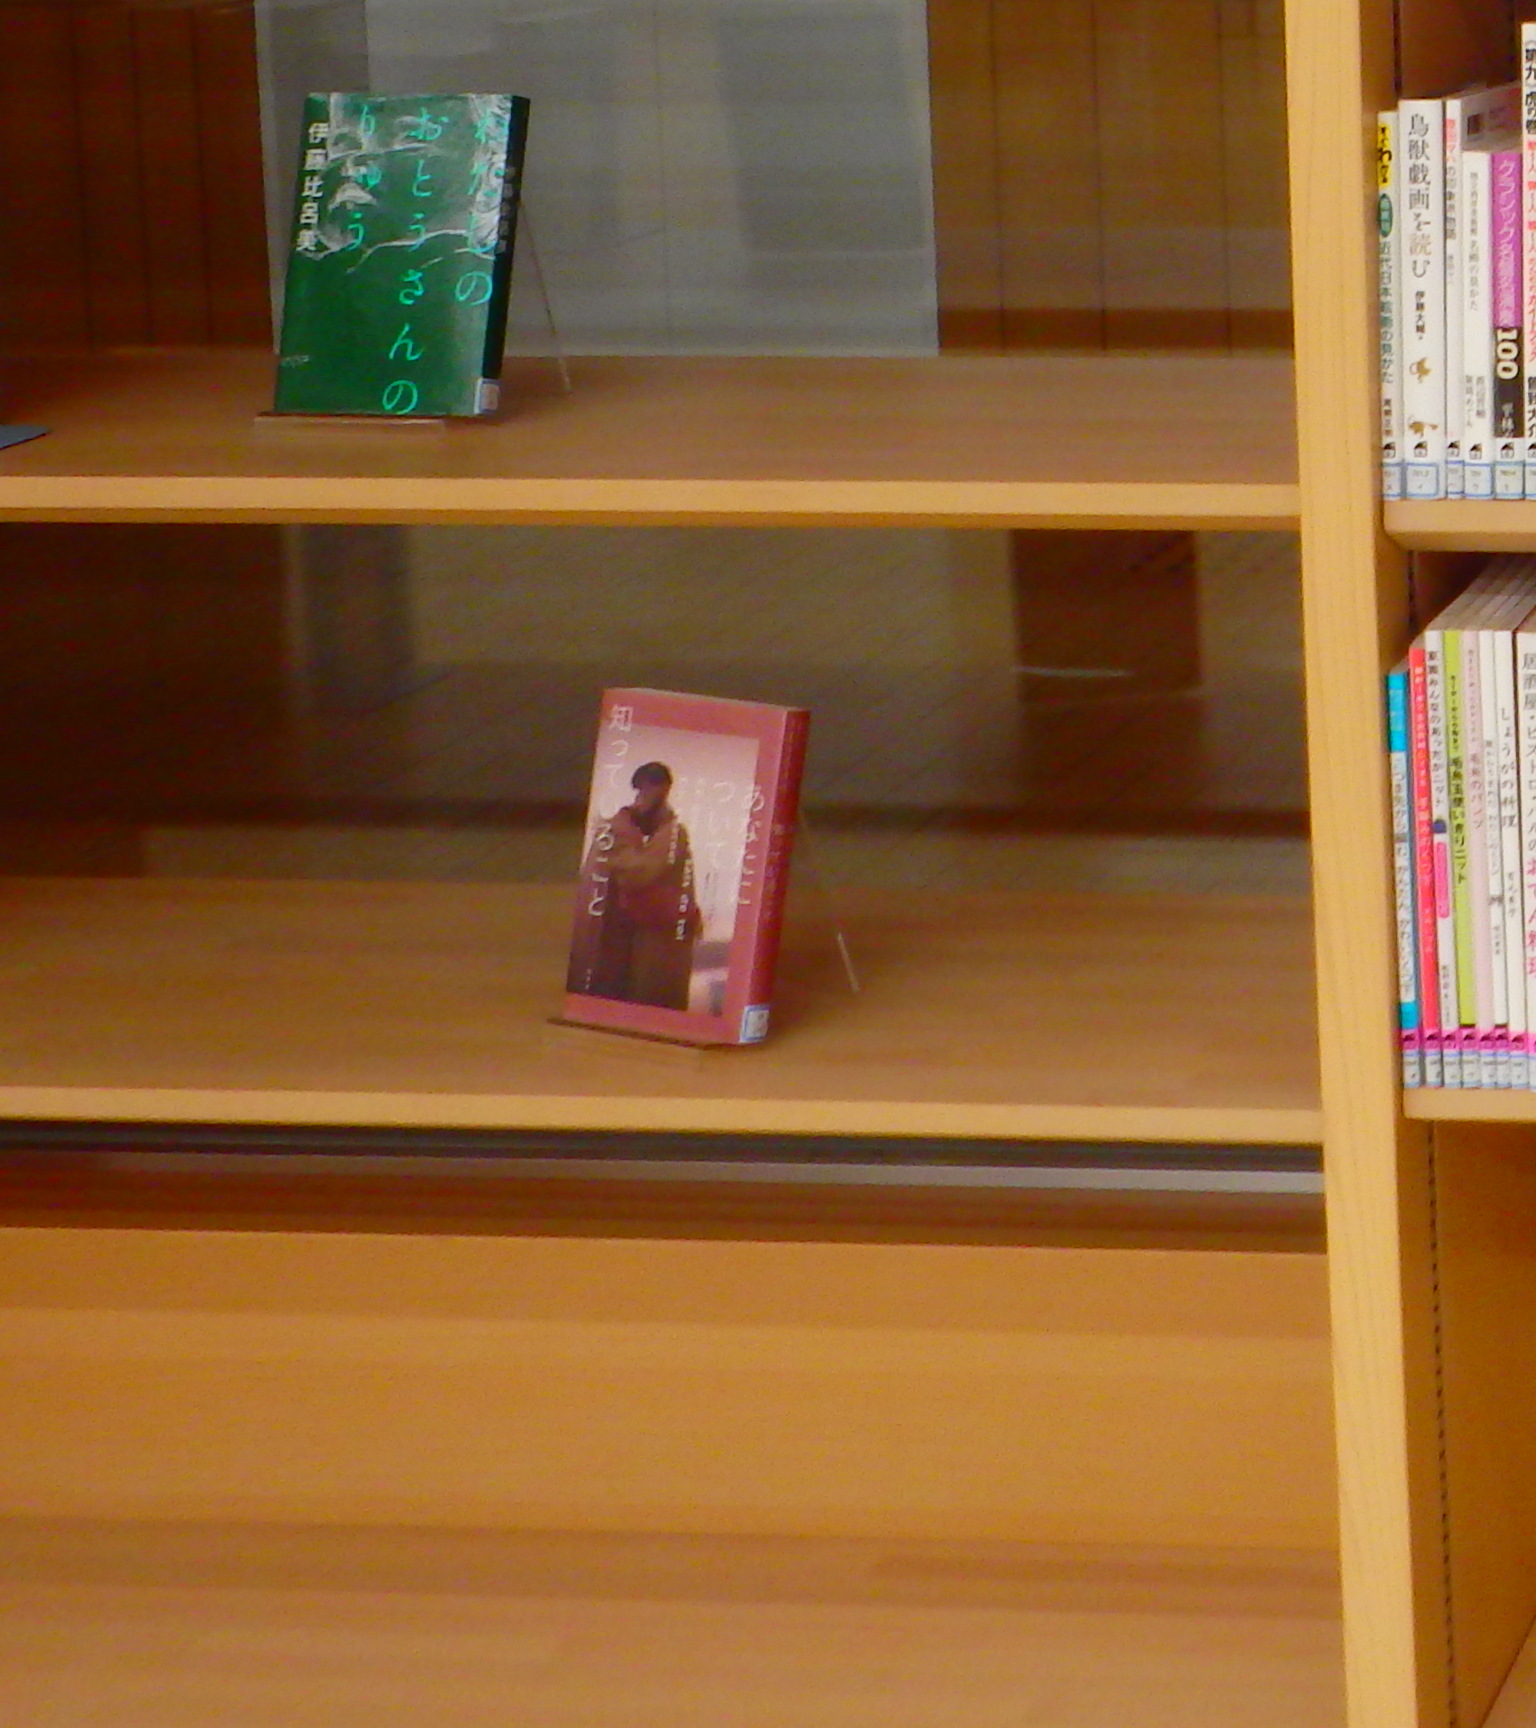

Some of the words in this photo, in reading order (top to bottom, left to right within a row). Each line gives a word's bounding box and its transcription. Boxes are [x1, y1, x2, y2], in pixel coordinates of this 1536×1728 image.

[297, 120, 332, 254] 伊藤比呂美
[382, 106, 449, 418] おとうさんの
[1407, 114, 1431, 278] 鳥獣戯画を読む
[587, 704, 634, 917] 知ってること
